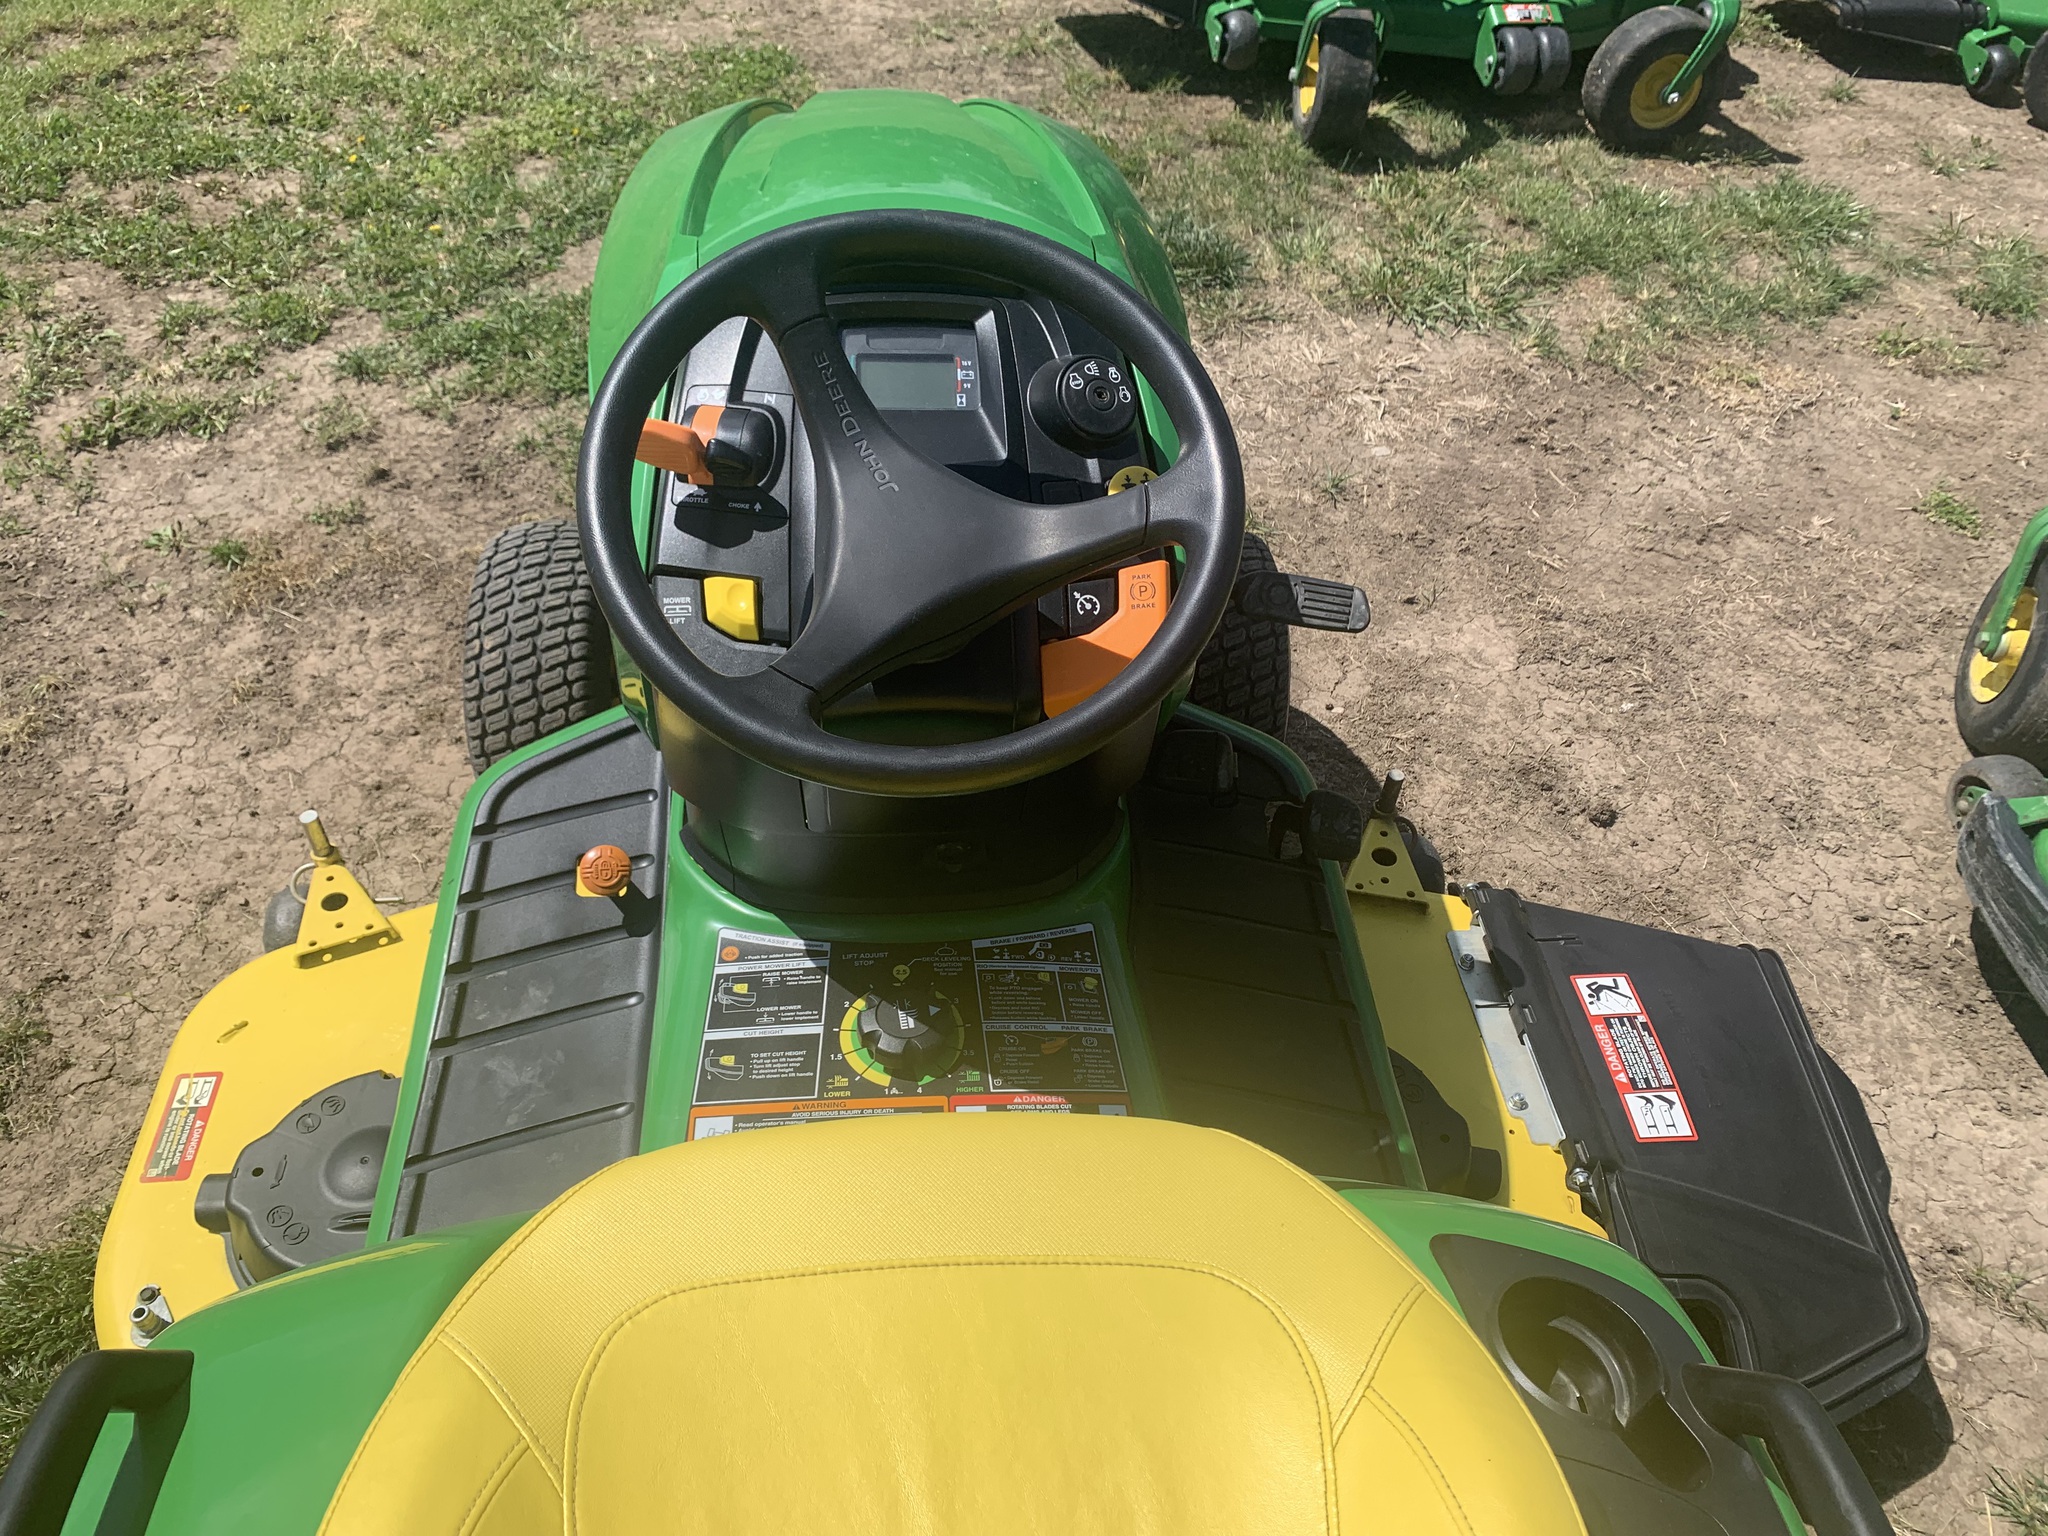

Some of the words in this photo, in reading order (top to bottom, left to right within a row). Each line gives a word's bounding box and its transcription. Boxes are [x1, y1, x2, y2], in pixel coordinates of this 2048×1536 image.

[813, 351, 860, 437] DEERE
[854, 438, 899, 492] JOHN
[735, 933, 765, 942] TRACTION
[1050, 928, 1077, 936] REVERSE
[1594, 1024, 1622, 1070] DANGER
[1609, 1028, 1621, 1047] BLADE
[1622, 1026, 1636, 1051] OBJECTS
[1618, 1048, 1633, 1078] ROTATING
[1633, 1052, 1647, 1078] THROWN
[802, 1101, 847, 1110] WARNING
[184, 1128, 202, 1161] DANGER
